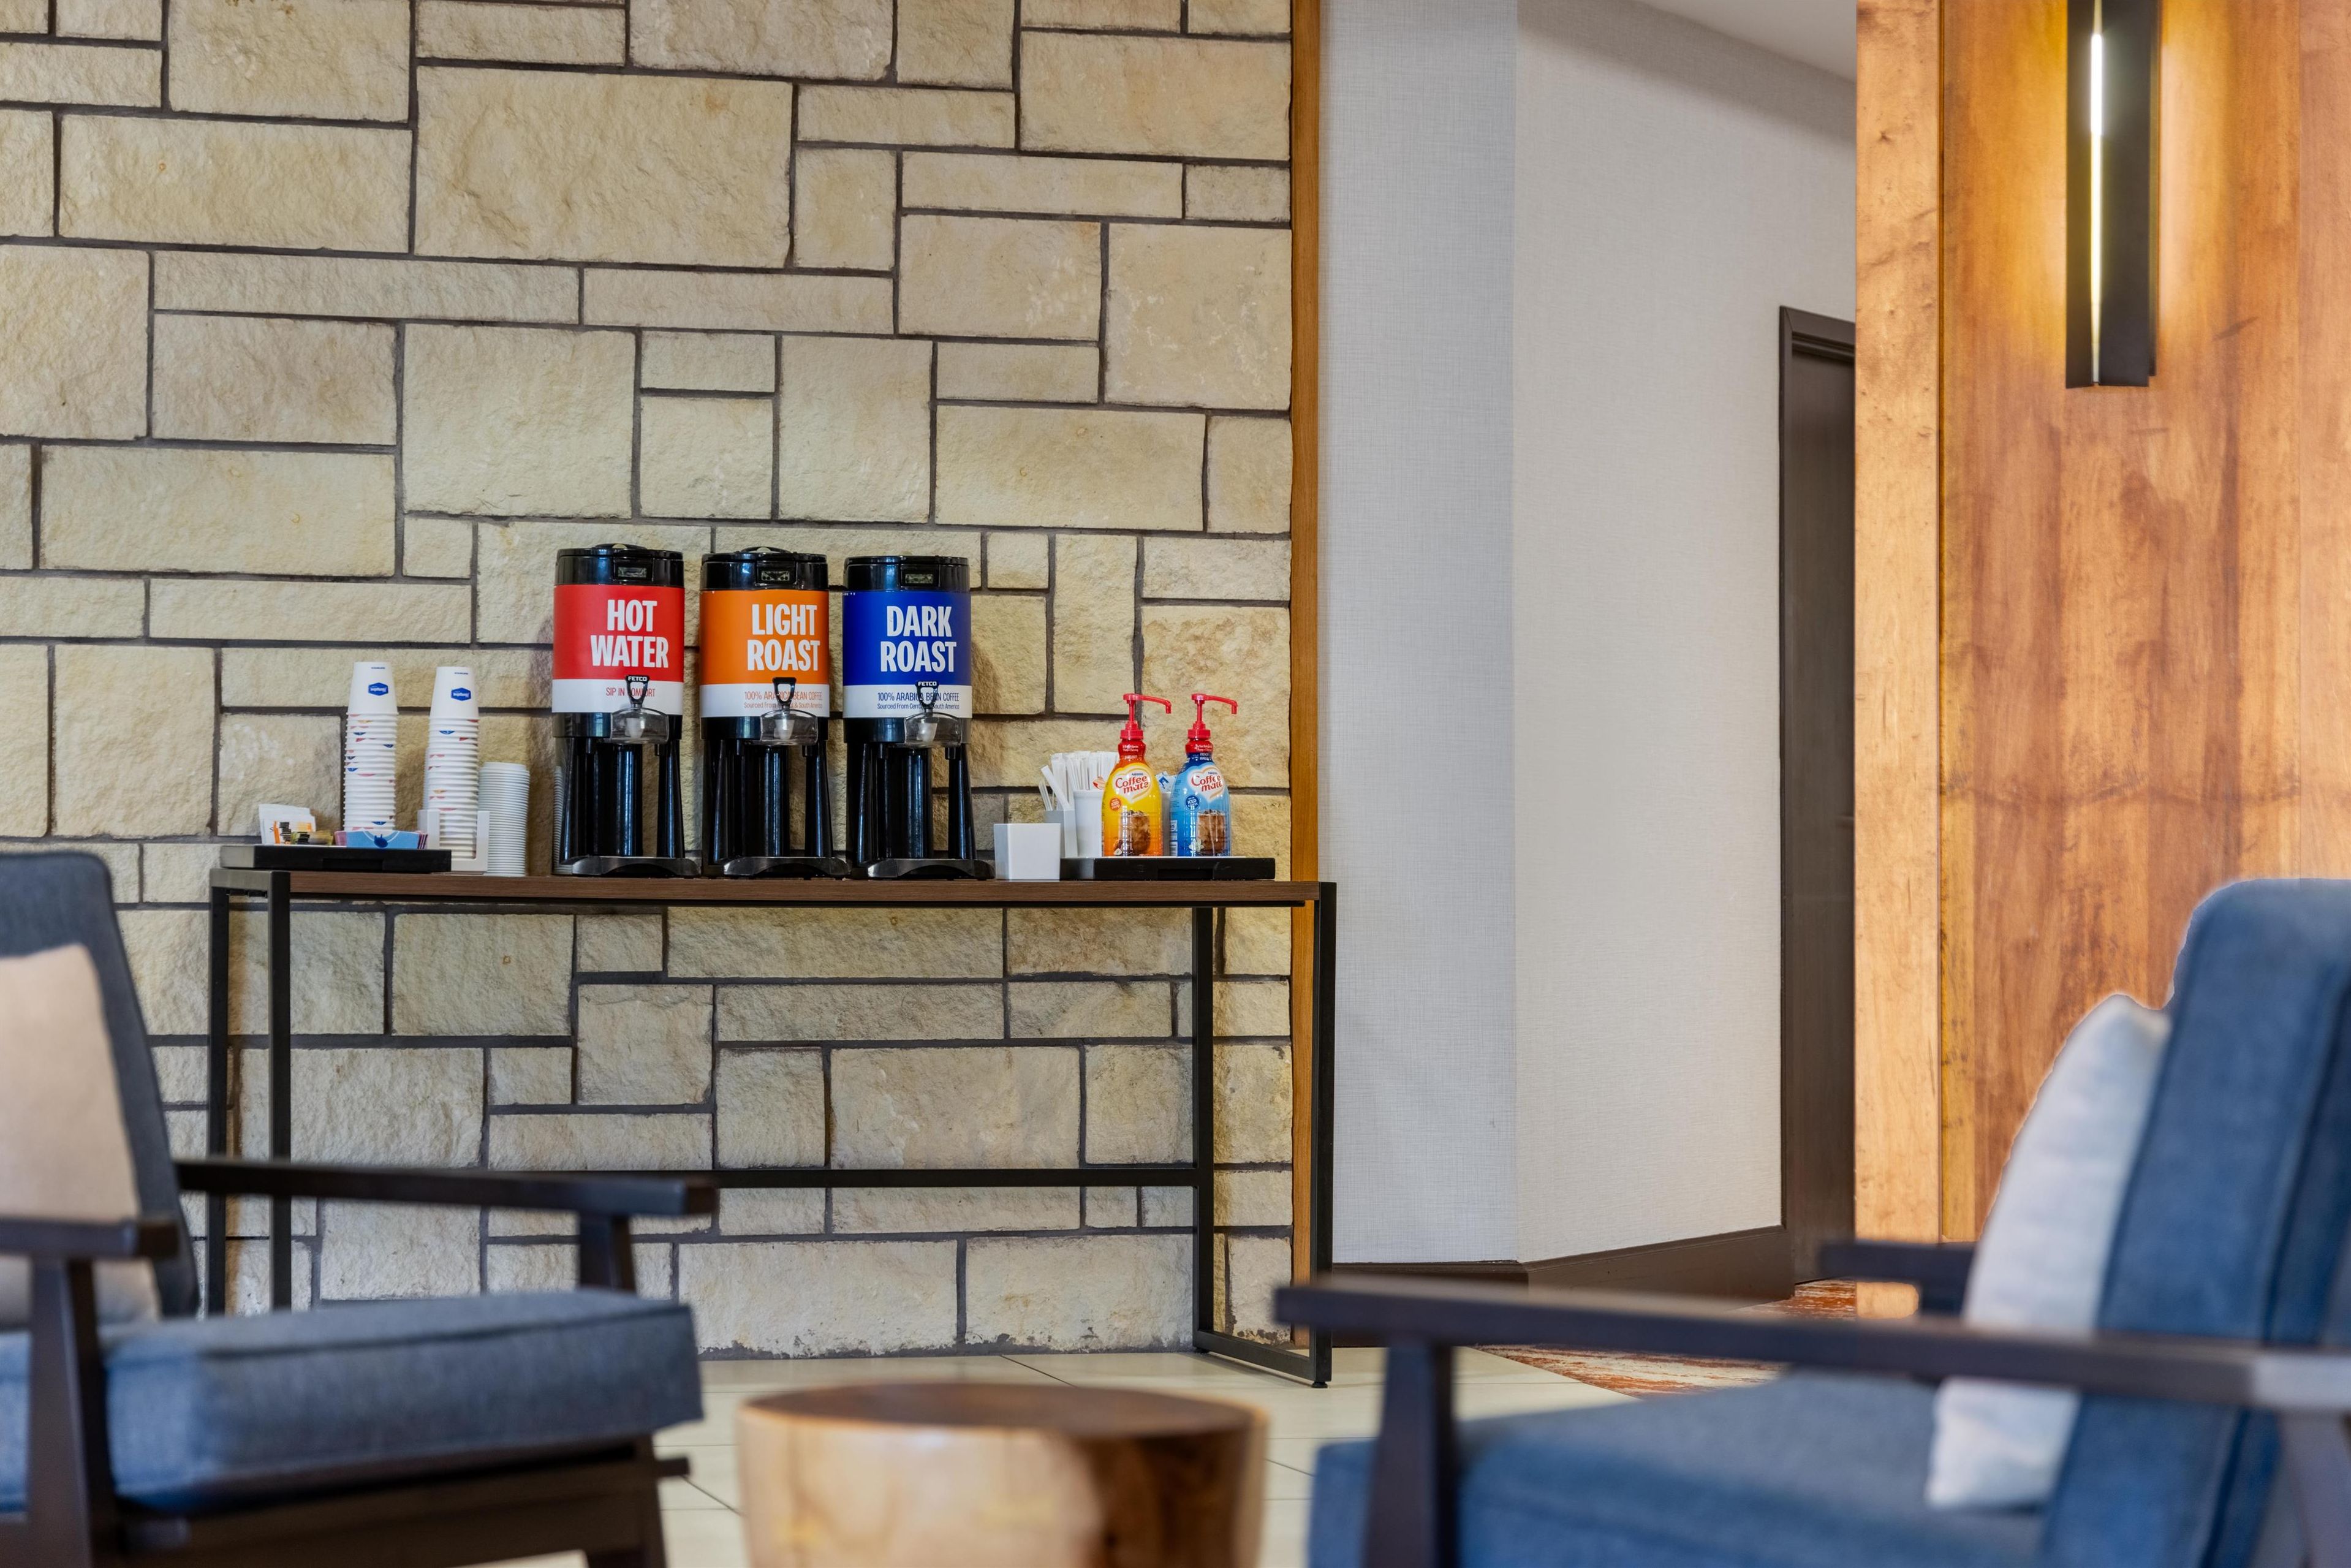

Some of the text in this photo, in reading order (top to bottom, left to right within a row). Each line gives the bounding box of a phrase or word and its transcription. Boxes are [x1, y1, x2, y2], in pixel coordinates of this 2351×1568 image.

[607, 599, 657, 632] HOT
[752, 604, 817, 635] LIGHT
[887, 606, 952, 637] DARK
[590, 635, 669, 668] WATER
[748, 639, 820, 671] ROAST
[880, 640, 956, 672] ROAST
[606, 687, 616, 696] SIP
[618, 687, 625, 696] IN
[745, 691, 762, 700] 100%
[793, 691, 808, 700] BEAN
[808, 691, 822, 700] COFFEE
[877, 692, 895, 701] 100%
[926, 692, 942, 701] BEN
[943, 692, 960, 702] COFFEE
[1115, 776, 1147, 789] Coffee
[1191, 775, 1221, 786] Coffee
[1202, 781, 1222, 792] mate
[1123, 781, 1149, 794] mate
